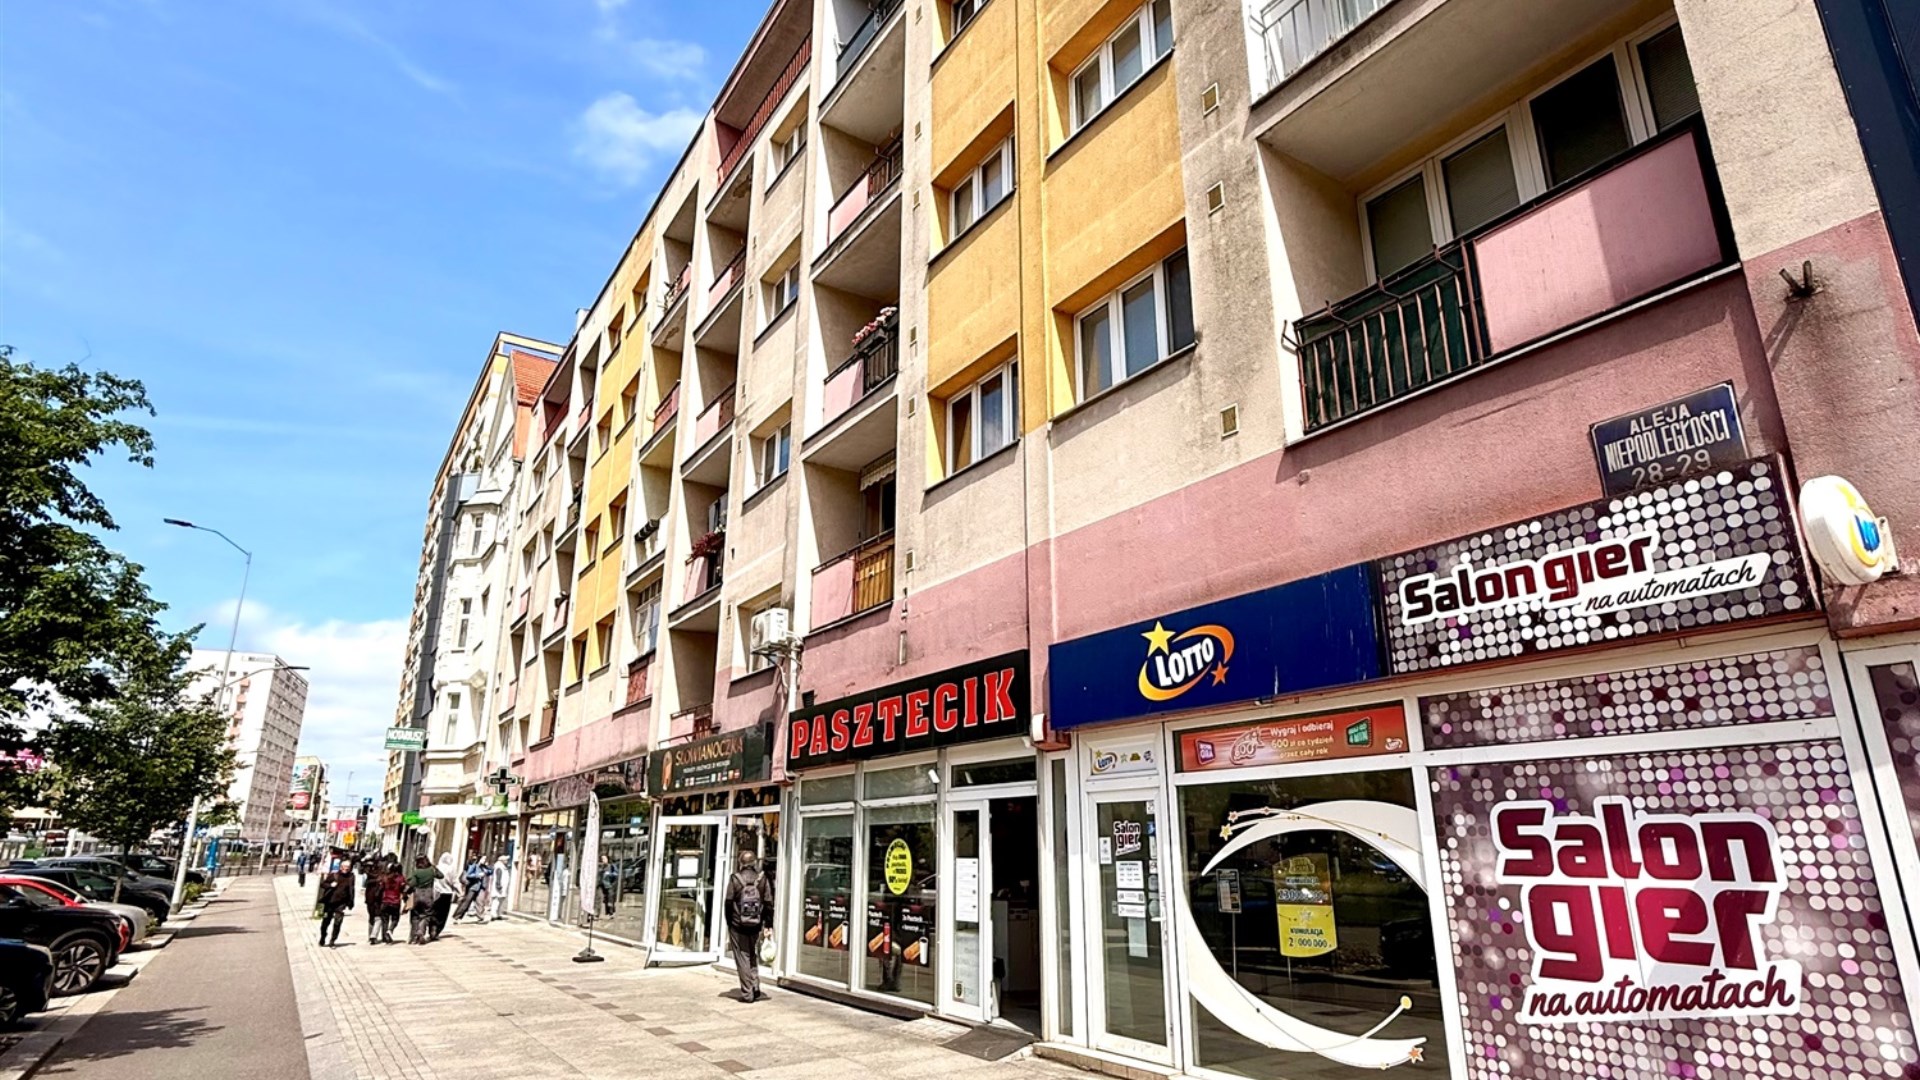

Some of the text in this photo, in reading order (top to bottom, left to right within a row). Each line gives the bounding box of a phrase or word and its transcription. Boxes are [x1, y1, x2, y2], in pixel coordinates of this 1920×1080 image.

[1604, 408, 1731, 473] NIEPODLEGŁOŚCI
[1629, 403, 1692, 435] ALEJA
[1405, 535, 1653, 619] Salon gier
[1584, 560, 1757, 612] na automatach
[1155, 637, 1214, 687] LOTTO
[790, 668, 1016, 759] PASZTECIK
[1270, 725, 1296, 737] Wygraj
[1302, 720, 1334, 733] odbieraj
[1271, 738, 1289, 748] 600
[1307, 735, 1334, 747] tydzień
[1114, 822, 1141, 834] Salon
[1117, 833, 1139, 849] gier
[1497, 803, 1777, 883] Salon
[1527, 885, 1770, 983] gier
[1530, 966, 1795, 1017] na automatach
